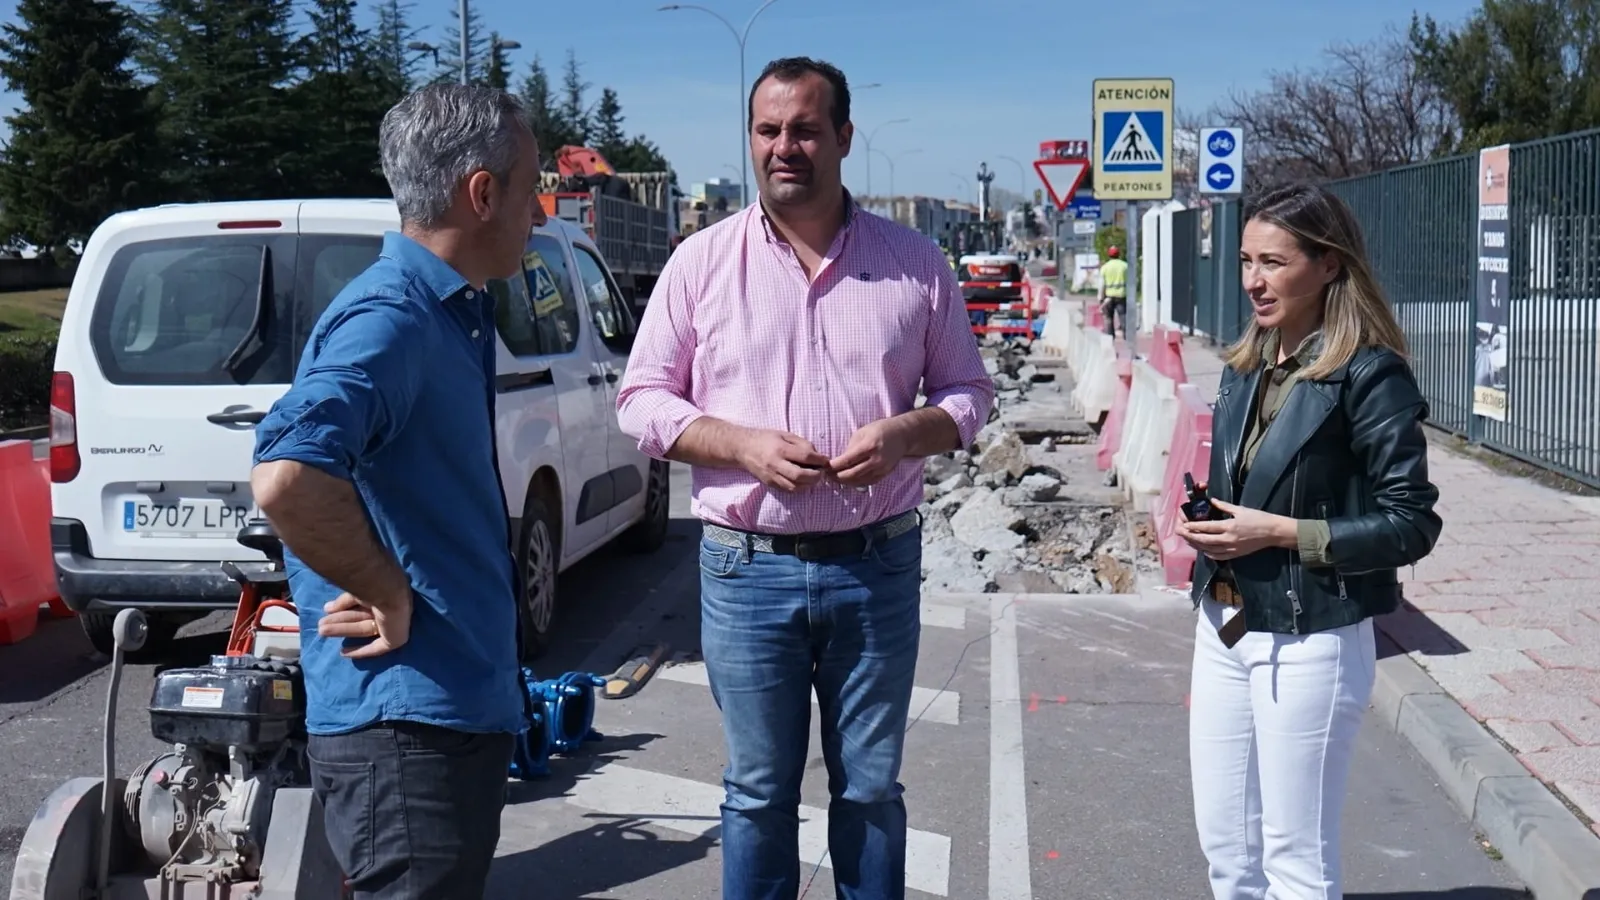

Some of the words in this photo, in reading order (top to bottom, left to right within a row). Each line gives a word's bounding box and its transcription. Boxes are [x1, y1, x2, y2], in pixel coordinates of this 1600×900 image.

[1098, 86, 1170, 100] ATENCIÓN
[1103, 182, 1163, 191] PEATONES
[90, 447, 146, 455] BERLINGO
[137, 505, 195, 527] 5707
[204, 505, 248, 527] LPR
